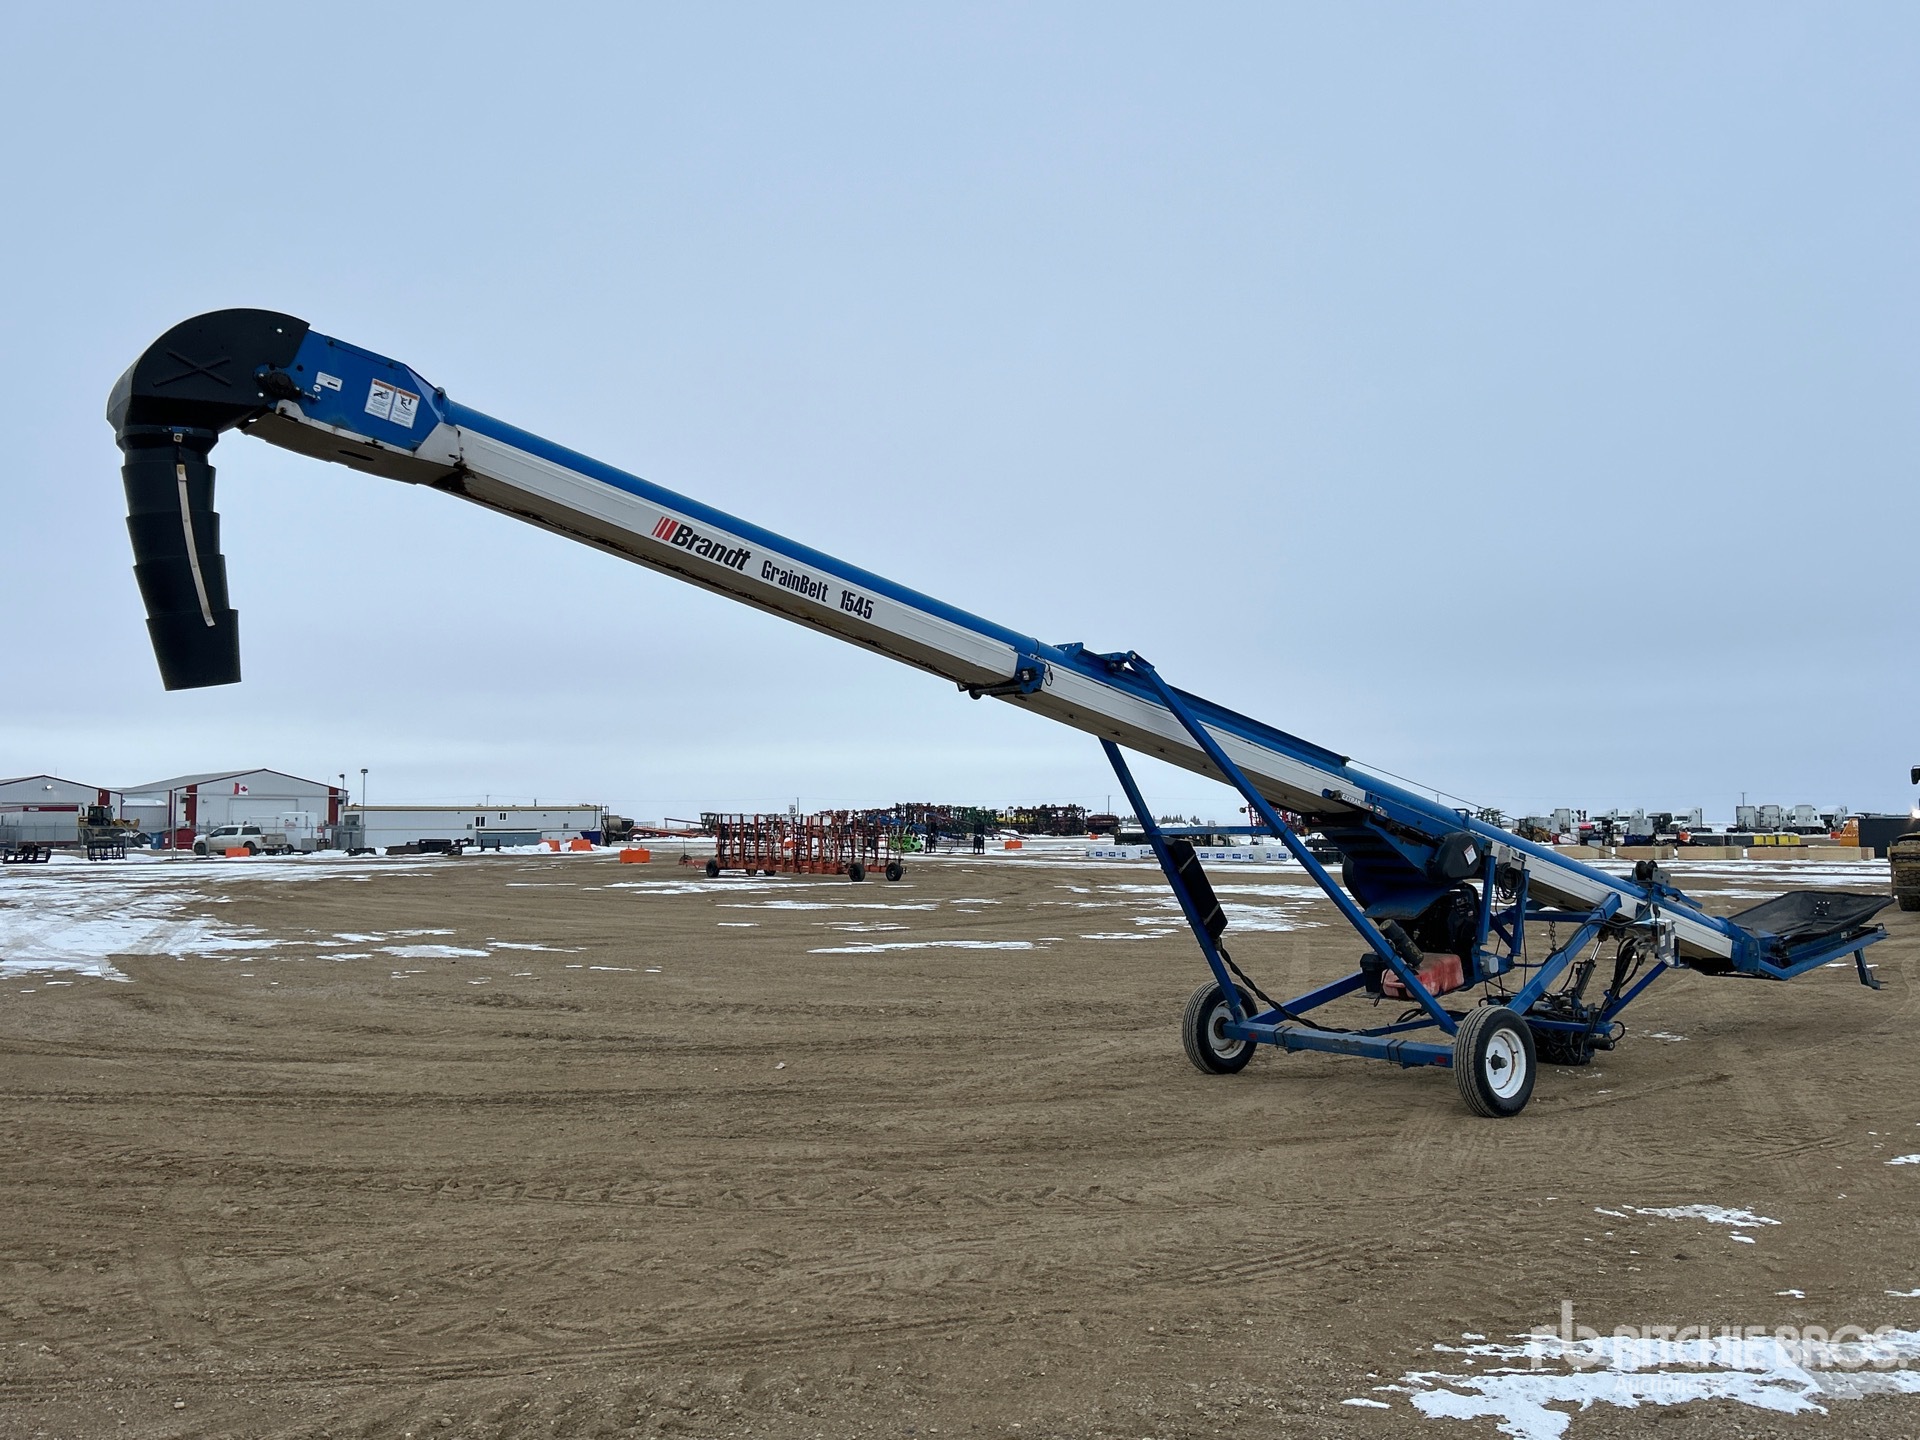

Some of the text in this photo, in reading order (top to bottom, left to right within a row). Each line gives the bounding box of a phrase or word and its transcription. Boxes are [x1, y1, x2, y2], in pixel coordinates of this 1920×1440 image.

[671, 523, 875, 620] Brandt GrainBelt 1545
